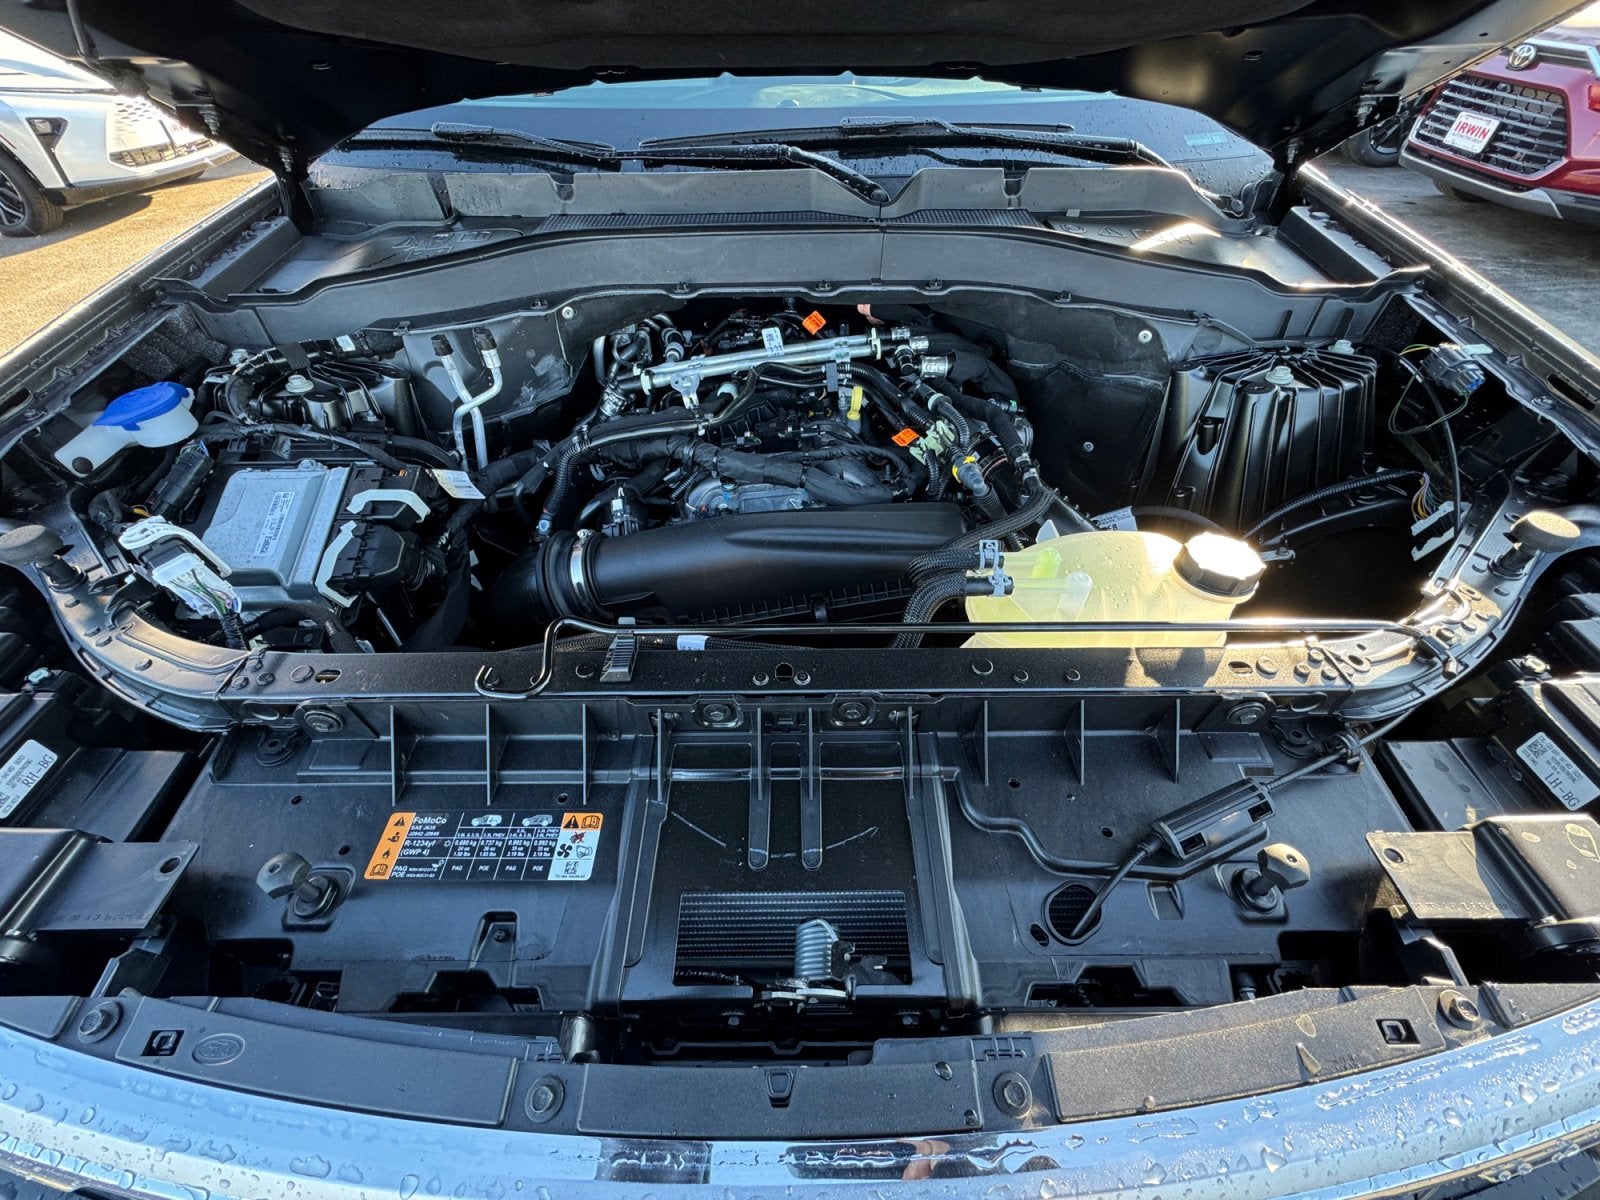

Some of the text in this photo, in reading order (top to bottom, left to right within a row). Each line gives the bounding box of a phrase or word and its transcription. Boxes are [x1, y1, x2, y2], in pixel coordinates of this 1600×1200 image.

[1455, 121, 1491, 139] IRWIN
[21, 754, 54, 788] RH-BG
[1545, 773, 1580, 807] LH-BG
[413, 816, 447, 824] FoMoCo
